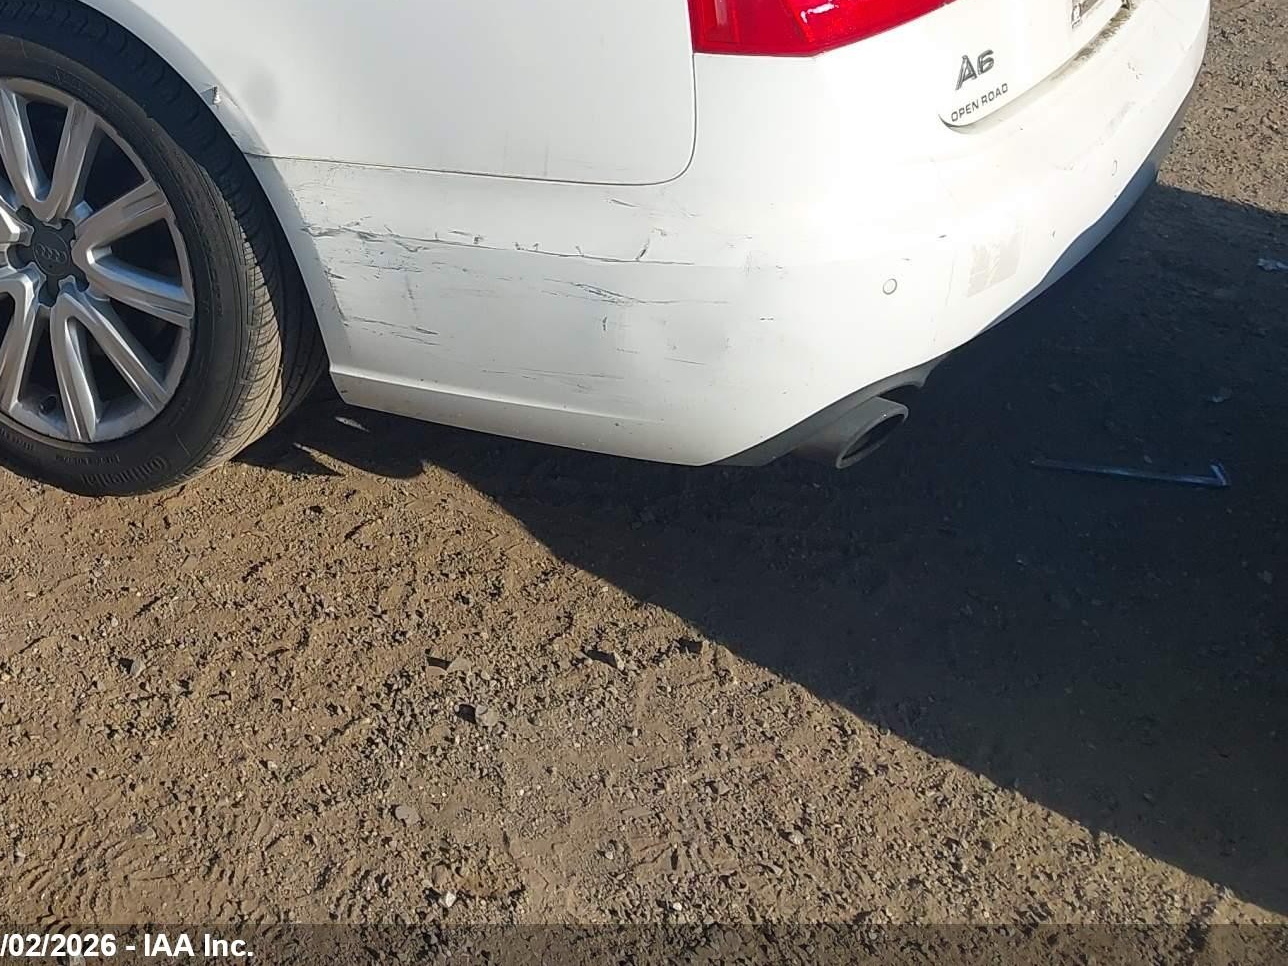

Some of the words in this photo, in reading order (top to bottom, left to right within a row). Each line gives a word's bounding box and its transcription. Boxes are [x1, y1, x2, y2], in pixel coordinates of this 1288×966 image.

[955, 49, 994, 91] A6
[950, 98, 979, 122] OPEN
[980, 82, 1008, 107] ROAD
